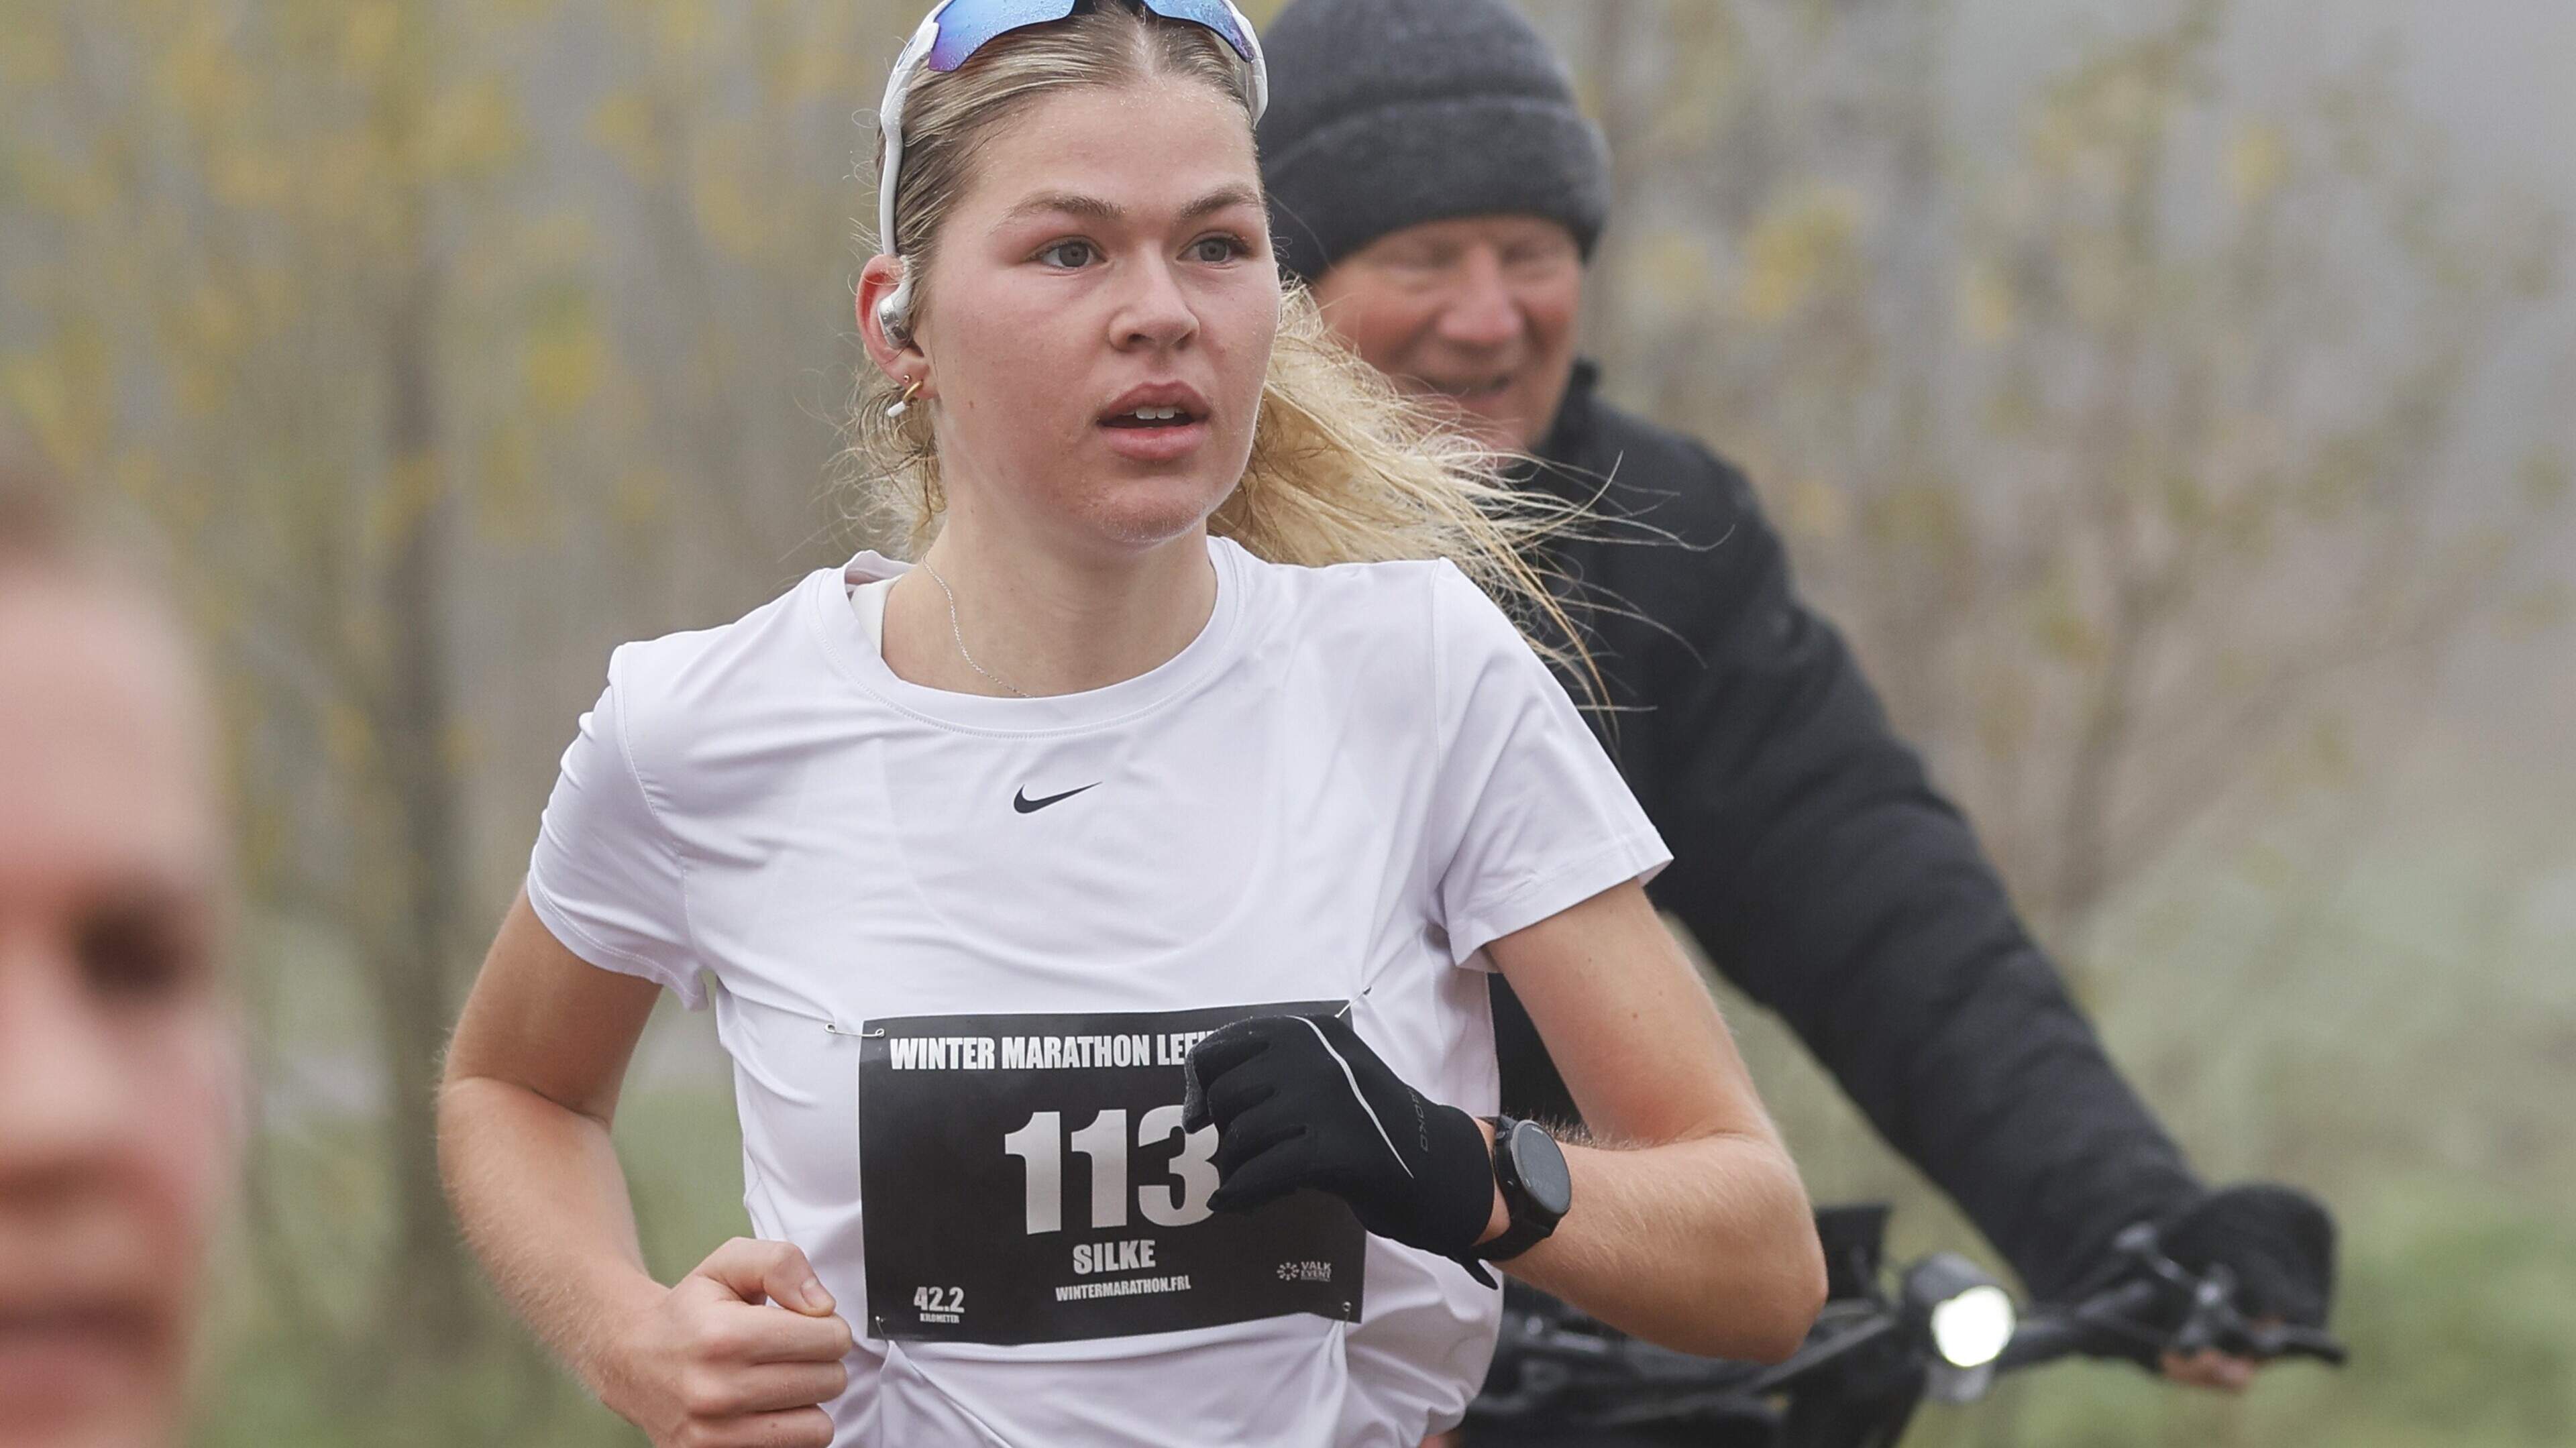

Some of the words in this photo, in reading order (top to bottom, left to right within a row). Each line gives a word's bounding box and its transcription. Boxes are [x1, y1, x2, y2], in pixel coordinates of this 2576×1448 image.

[890, 1038, 995, 1070] WINTER
[1002, 1034, 1150, 1069] MARATHON
[1005, 1105, 1220, 1235] 113
[1073, 1239, 1156, 1274] SILKE
[1301, 1261, 1331, 1272] VALK
[914, 1286, 965, 1313] 42.2
[1055, 1275, 1191, 1301] WINTERMARATHON.FRL
